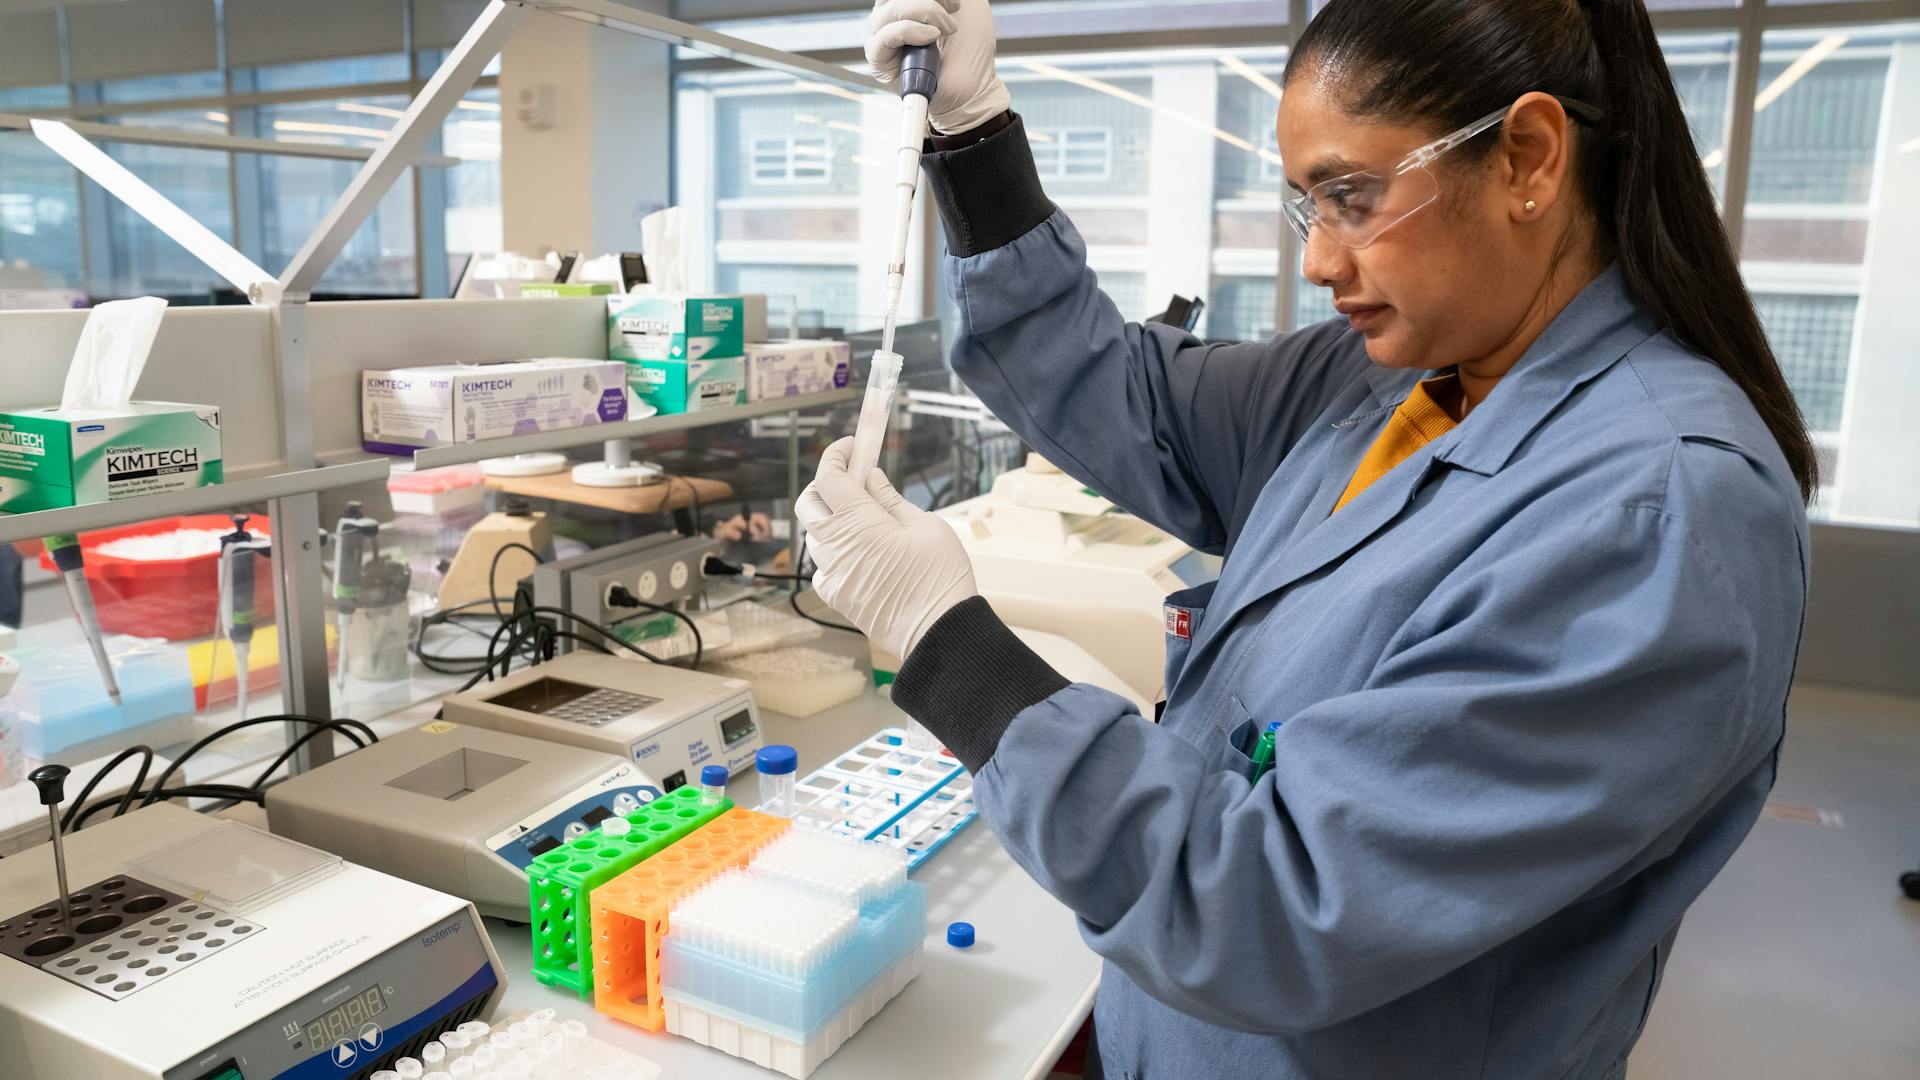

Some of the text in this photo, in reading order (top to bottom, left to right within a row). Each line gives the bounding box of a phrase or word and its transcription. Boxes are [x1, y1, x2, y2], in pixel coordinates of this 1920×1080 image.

[622, 320, 669, 330] KIMTECH
[367, 379, 411, 390] KIMTECH
[462, 379, 512, 393] KIMTECH
[106, 446, 142, 455] Kimwipes
[107, 448, 198, 473] KIMTECH
[1178, 620, 1187, 628] FR
[422, 922, 461, 948] Isotemp
[238, 972, 284, 996] CAUTION
[305, 938, 346, 961] SURFACE
